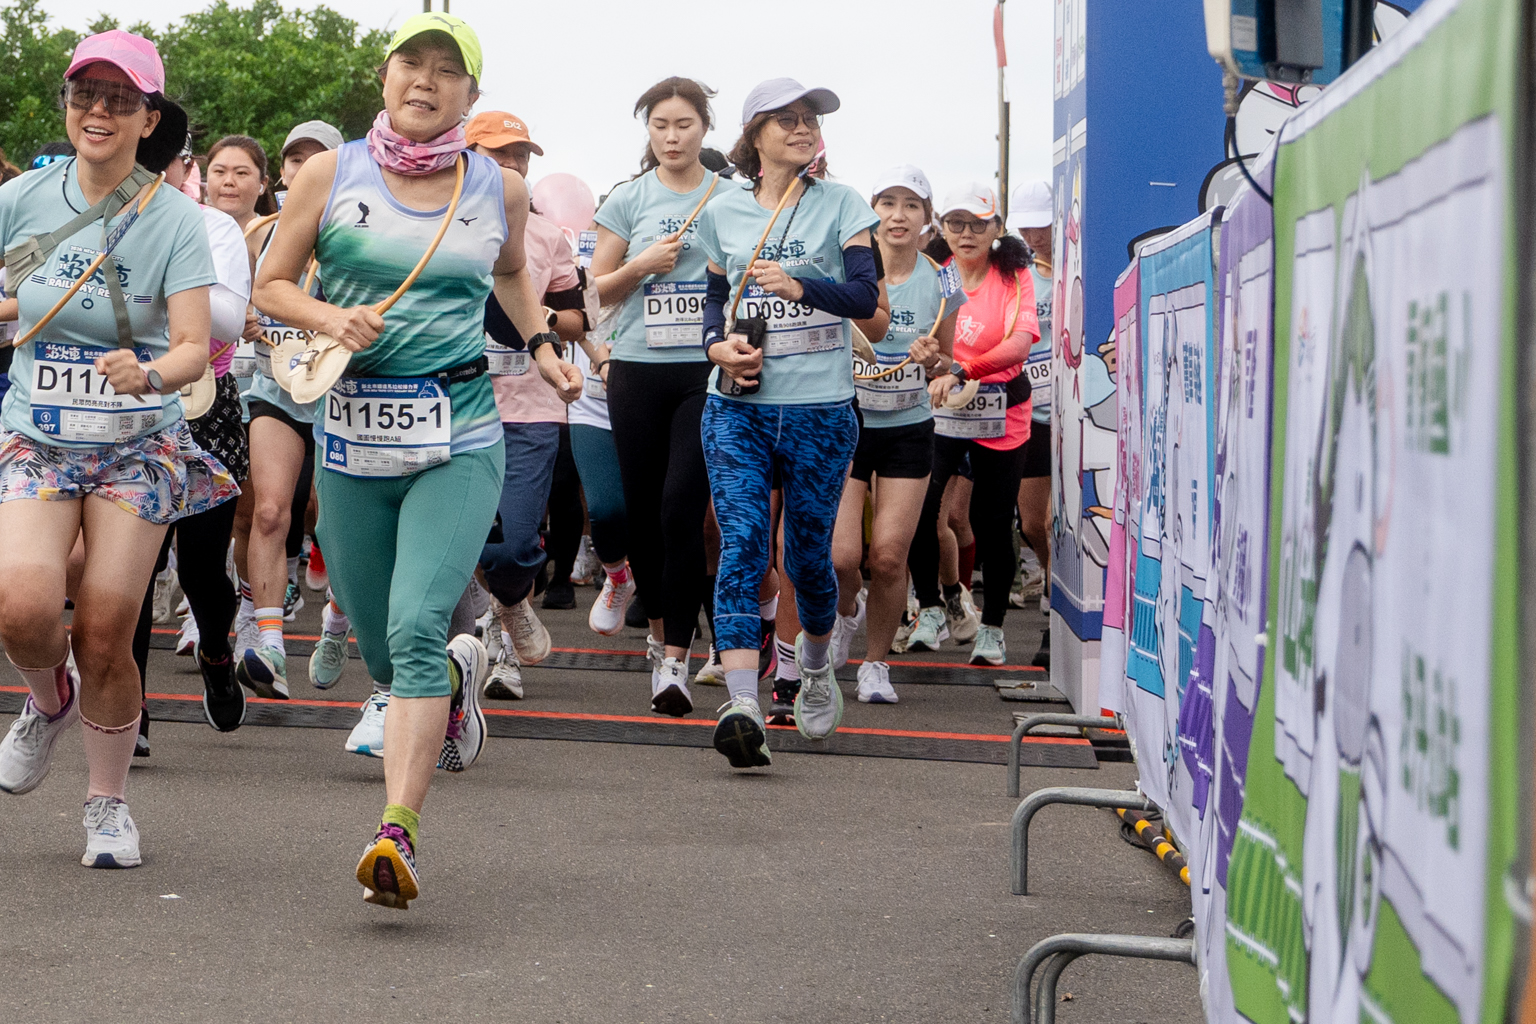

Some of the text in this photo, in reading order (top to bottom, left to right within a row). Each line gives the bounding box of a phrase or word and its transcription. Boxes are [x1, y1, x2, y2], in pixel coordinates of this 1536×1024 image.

[579, 241, 597, 249] D10
[786, 258, 810, 267] RELAY
[97, 287, 132, 303] REY
[747, 300, 815, 321] D0939
[329, 394, 442, 430] D1155-1
[37, 423, 56, 433] 397
[329, 451, 345, 462] 080
